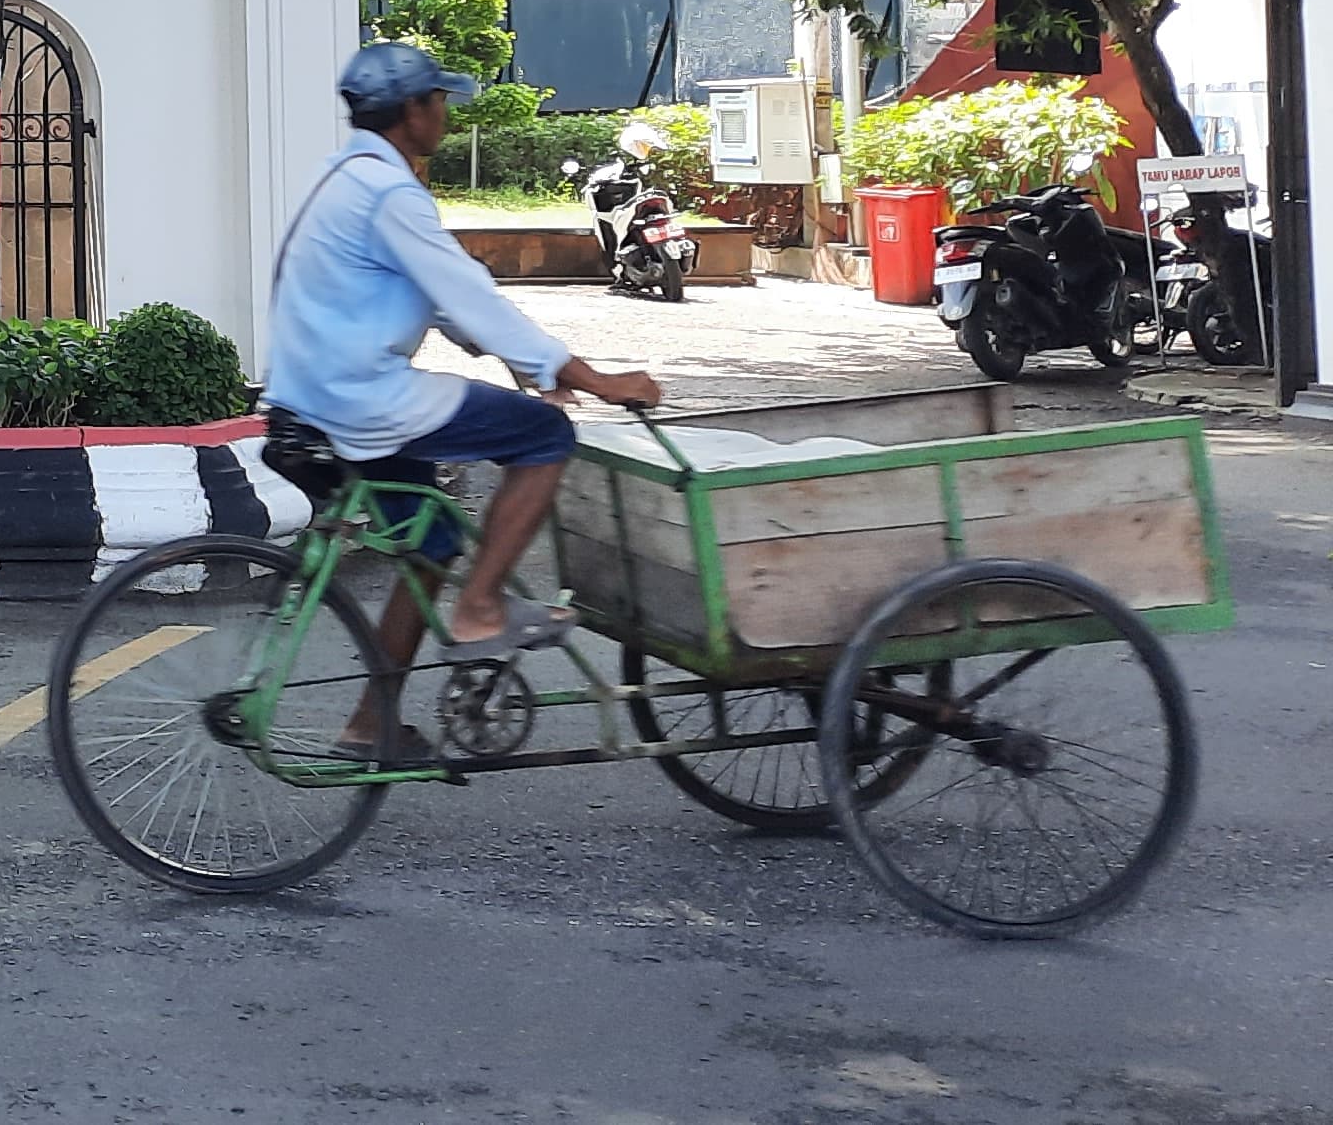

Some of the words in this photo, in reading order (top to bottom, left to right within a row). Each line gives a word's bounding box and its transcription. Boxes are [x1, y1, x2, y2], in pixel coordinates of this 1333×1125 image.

[1142, 170, 1168, 182] TAMU
[1172, 167, 1204, 181] HARAP
[1208, 166, 1241, 178] LAPOR
